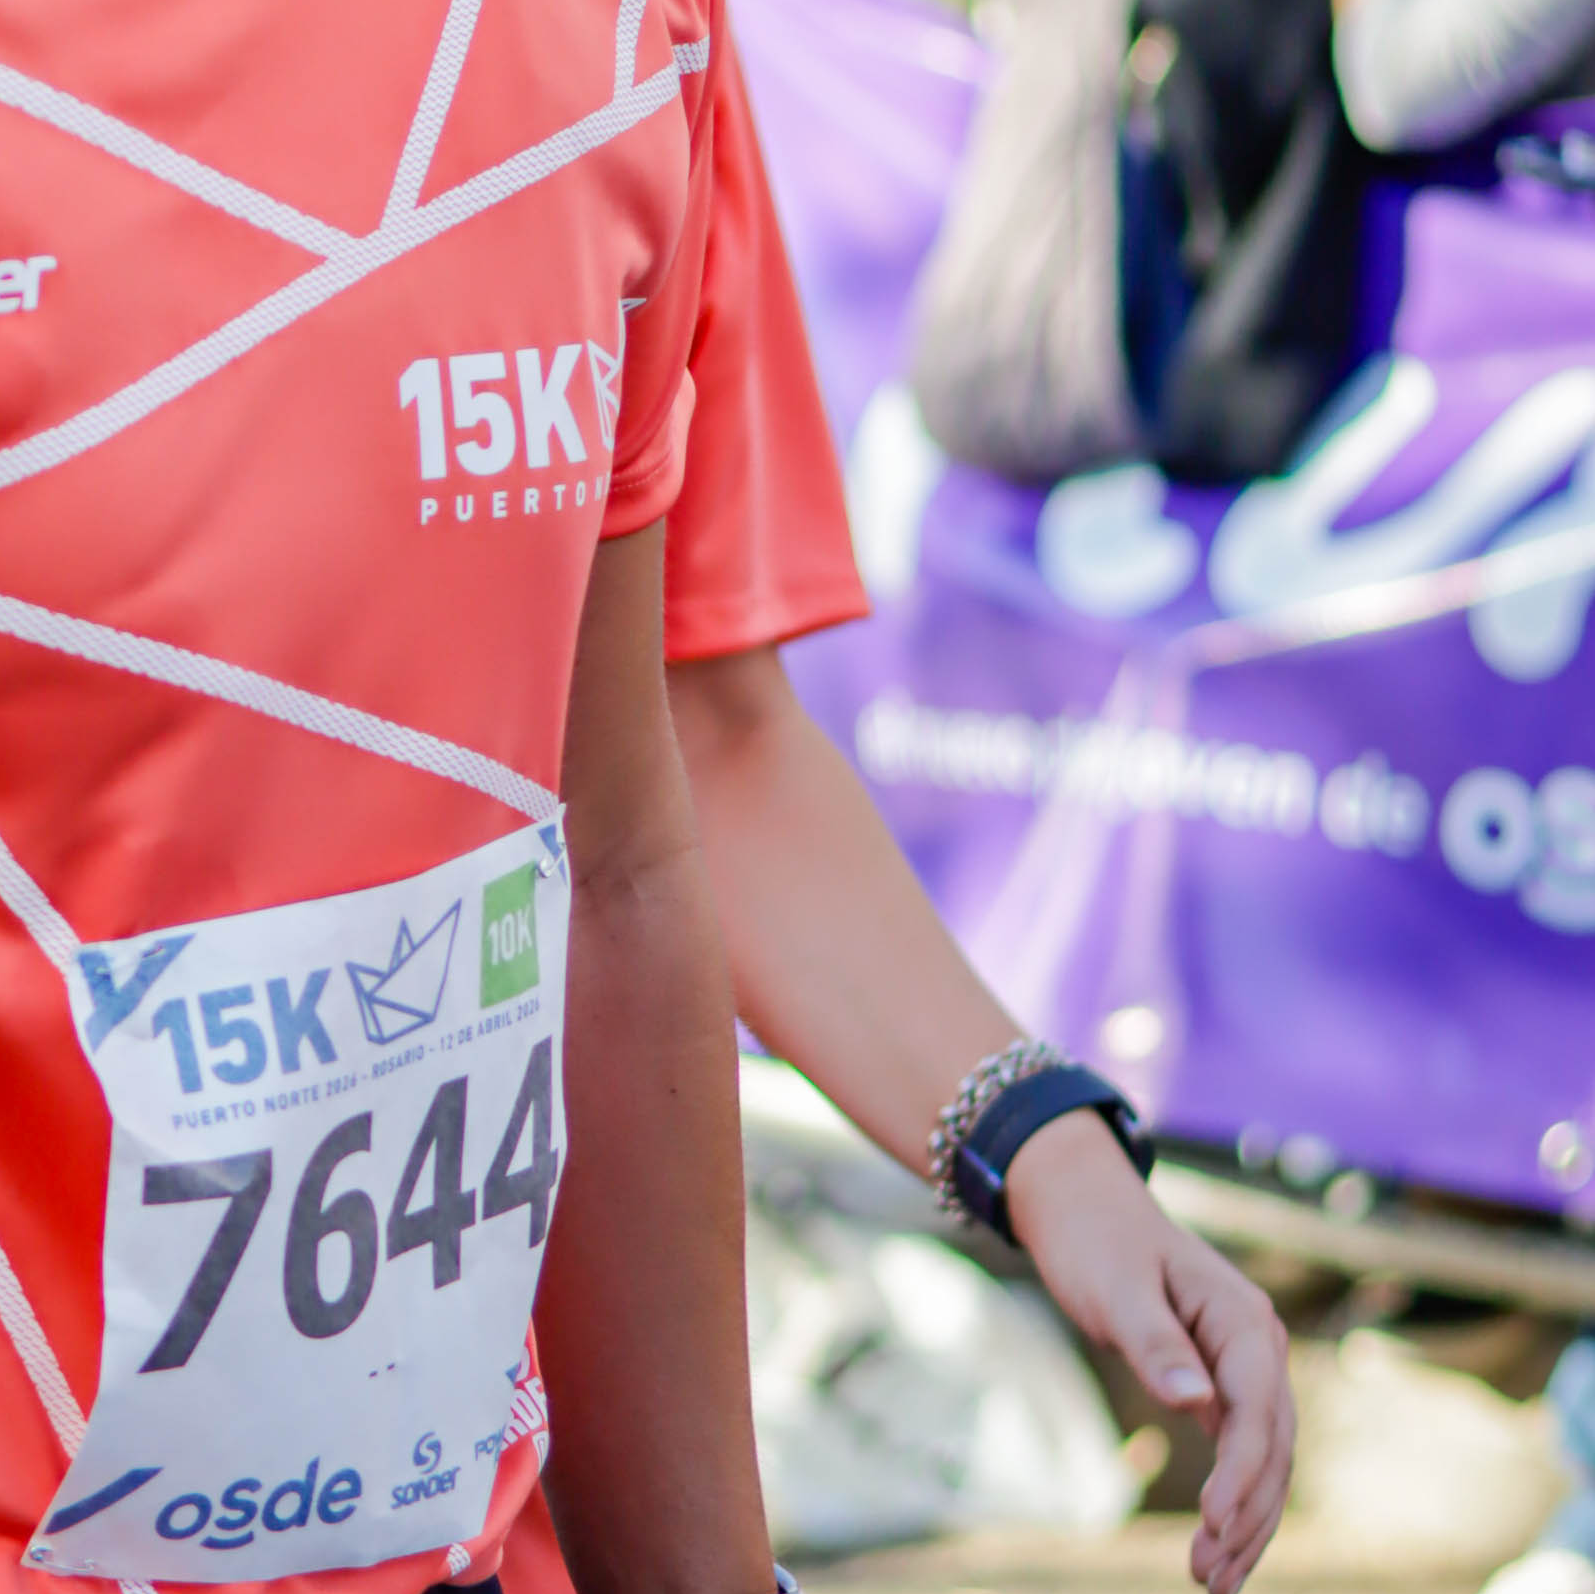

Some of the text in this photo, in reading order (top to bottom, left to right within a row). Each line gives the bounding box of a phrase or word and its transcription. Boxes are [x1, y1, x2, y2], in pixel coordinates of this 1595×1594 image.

[398, 343, 588, 480] 15K
[489, 904, 533, 966] 10K
[152, 966, 337, 1093] 15K
[171, 1100, 256, 1131] PUERTO
[263, 1084, 319, 1113] NORTE
[325, 1075, 357, 1098] 2026
[371, 1044, 425, 1078] ROSARIO
[440, 1033, 453, 1051] 12
[457, 1025, 473, 1045] DE
[477, 1011, 513, 1037] ABRIL
[137, 1036, 559, 1373] 7644
[155, 1458, 362, 1550] osde
